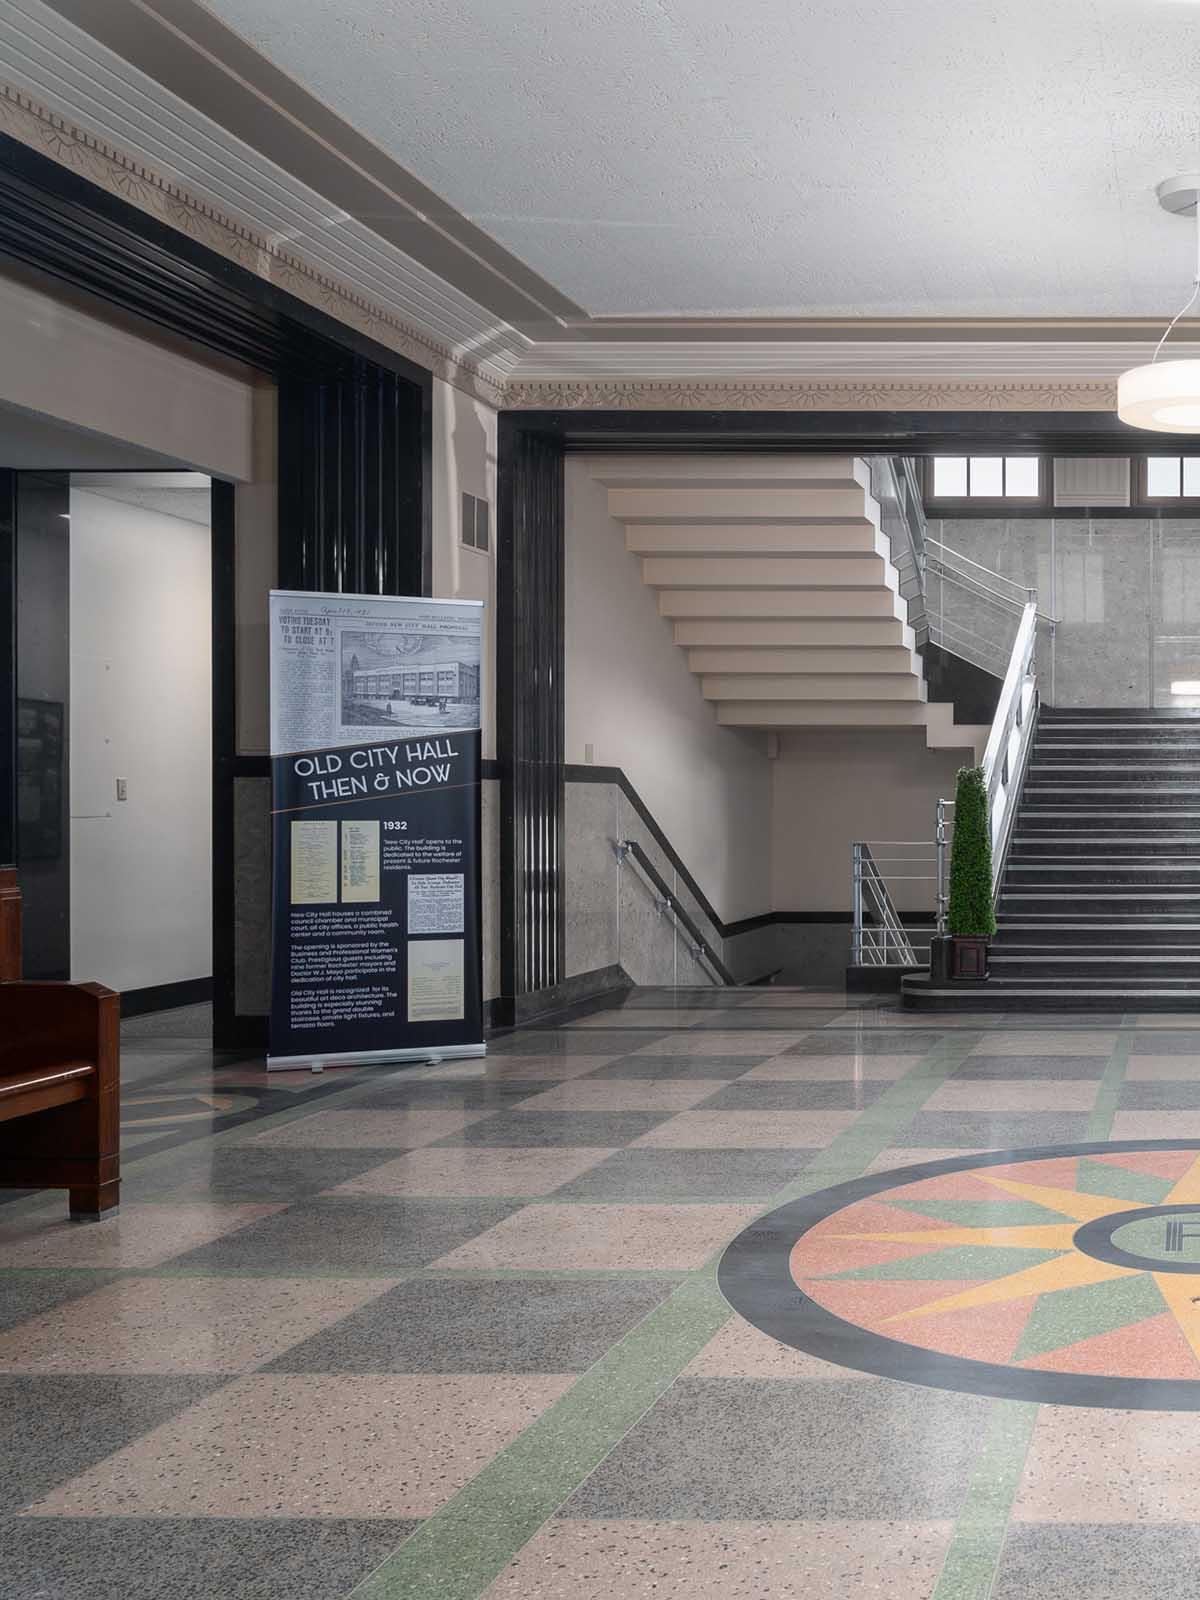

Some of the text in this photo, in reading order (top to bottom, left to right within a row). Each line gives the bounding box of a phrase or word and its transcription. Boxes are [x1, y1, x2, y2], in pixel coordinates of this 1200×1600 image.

[303, 617, 330, 625] TUESDAY
[292, 626, 312, 635] START
[315, 627, 322, 635] AT
[284, 635, 291, 643] TO
[296, 636, 314, 645] CLOSE
[295, 740, 458, 776] OLD CITY HALL
[308, 764, 450, 800] THEN & NOW
[384, 821, 407, 830] 1932
